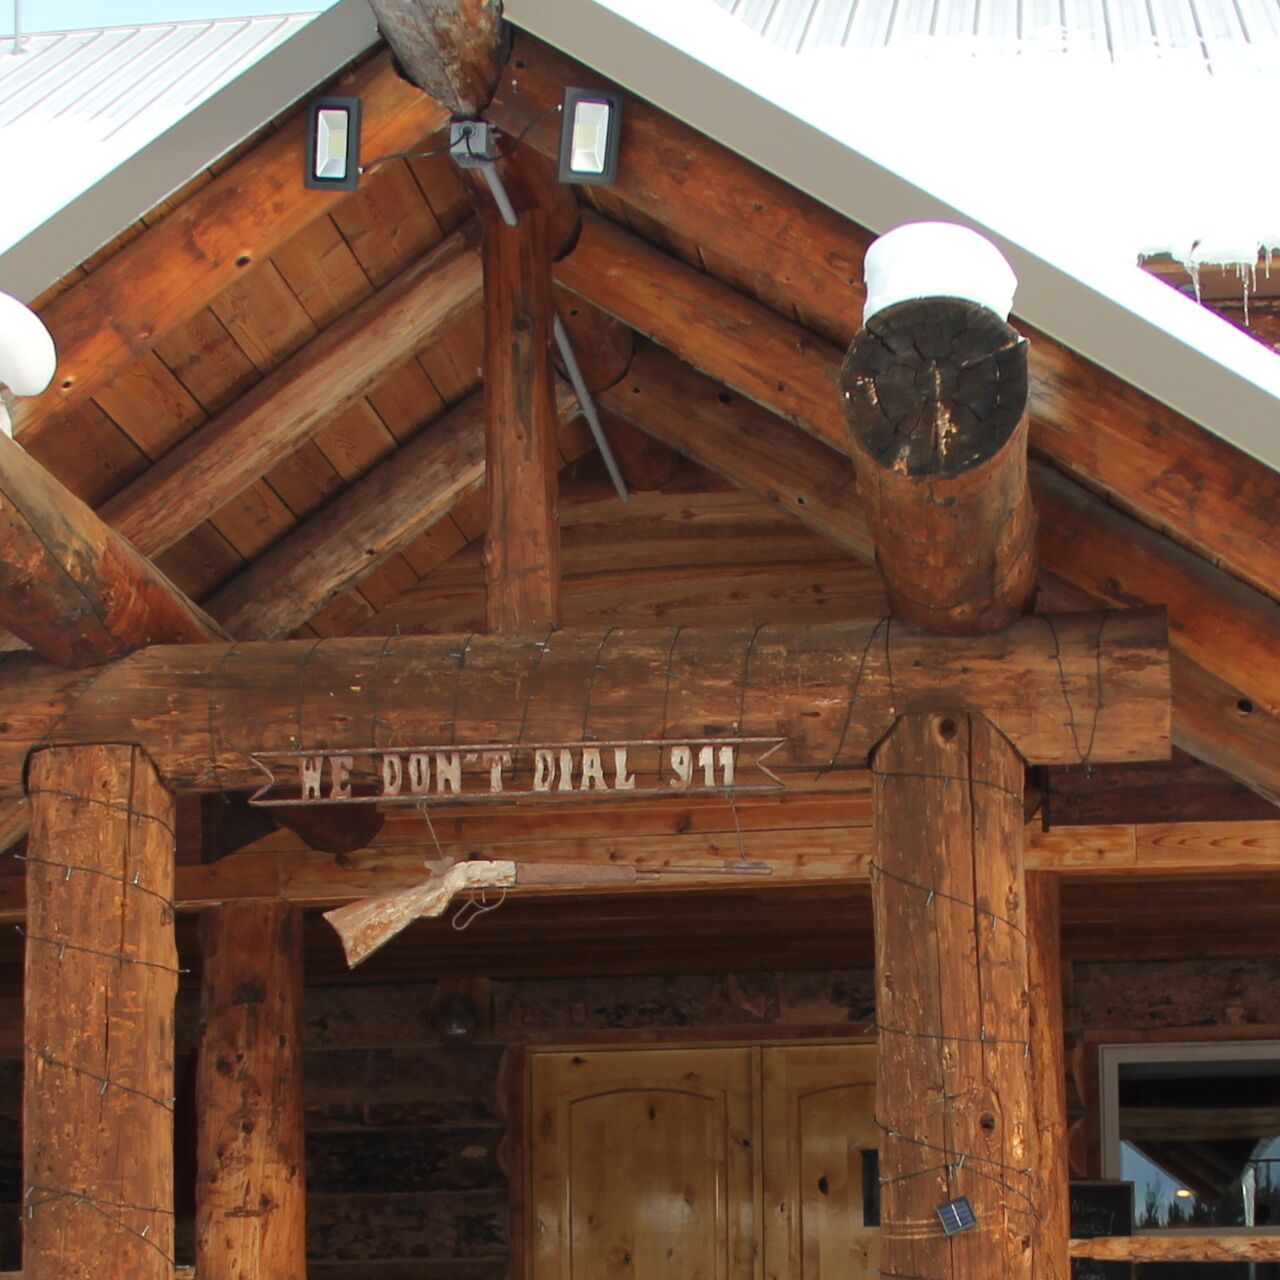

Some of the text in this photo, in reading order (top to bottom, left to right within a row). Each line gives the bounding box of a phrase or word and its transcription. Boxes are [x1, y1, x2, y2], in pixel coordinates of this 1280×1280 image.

[299, 745, 735, 800] WE DON'T DIAL 911
